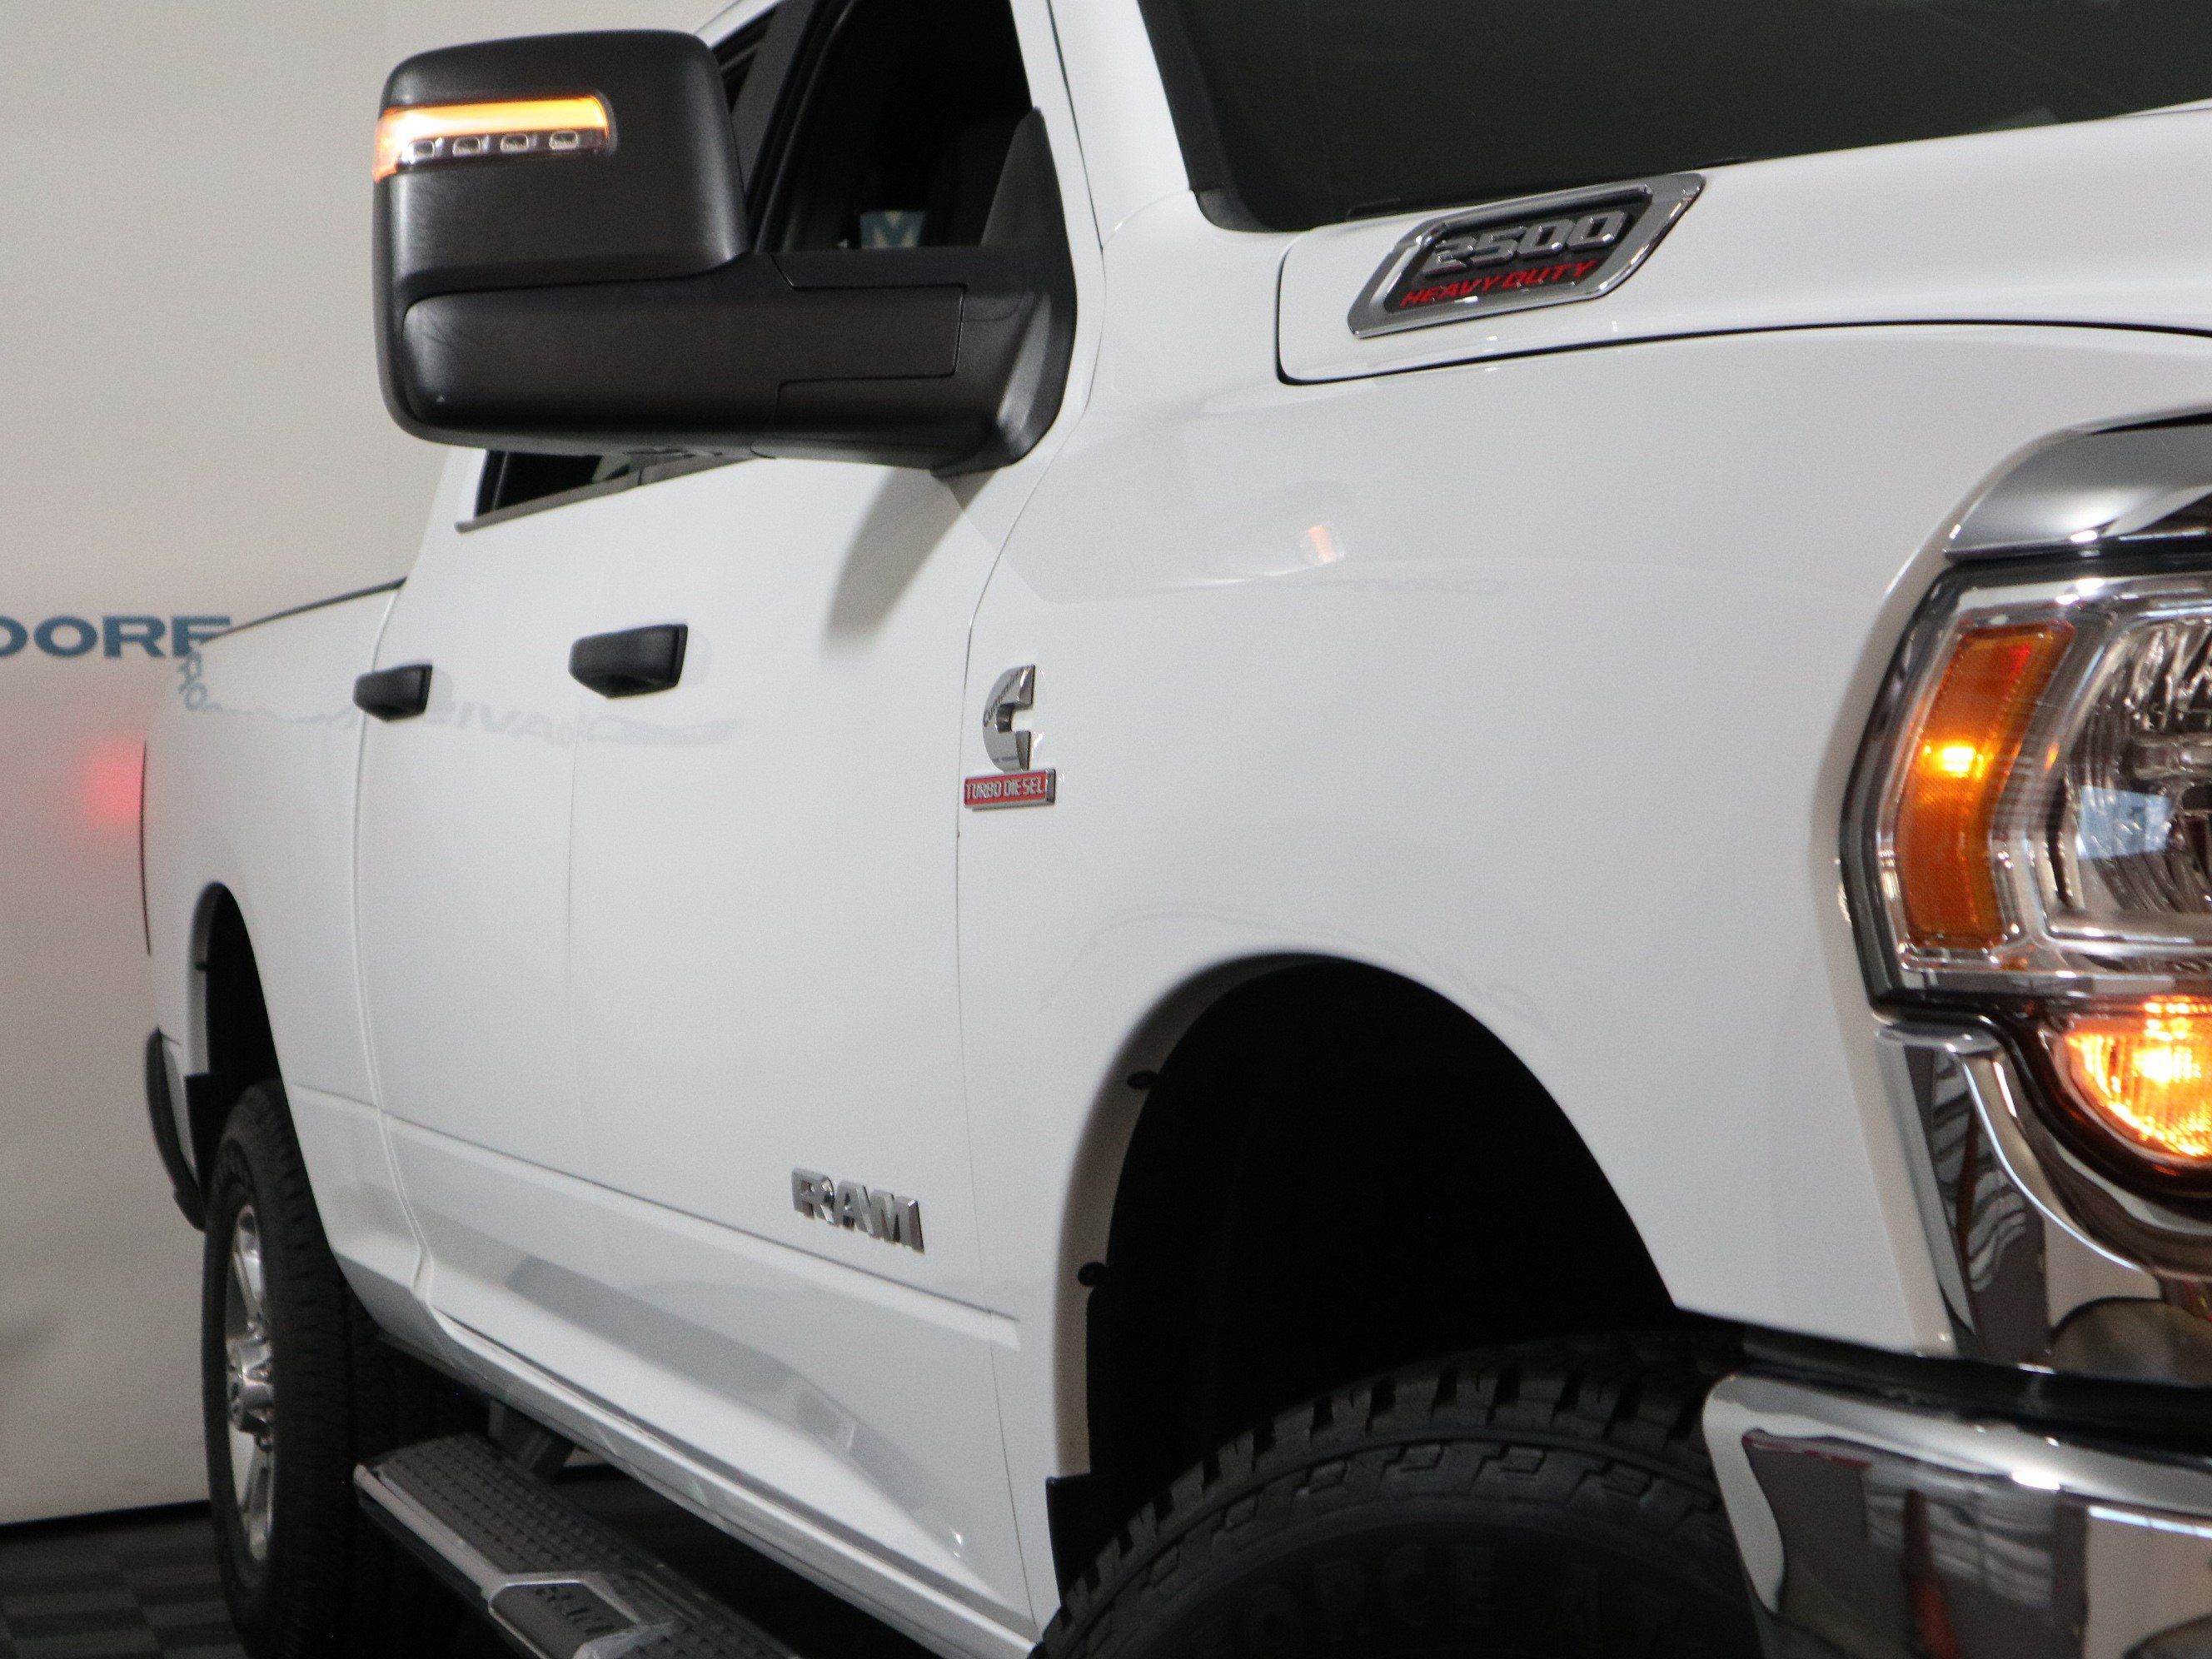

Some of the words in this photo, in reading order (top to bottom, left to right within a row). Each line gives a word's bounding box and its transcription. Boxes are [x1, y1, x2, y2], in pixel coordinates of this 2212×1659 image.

[1421, 211, 1627, 278] 2500
[1399, 276, 1502, 308] HEAVY
[1501, 260, 1597, 289] DUTY
[965, 779, 1002, 801] TURBO
[1004, 775, 1046, 800] DIESEL
[791, 1168, 925, 1254] RAM
